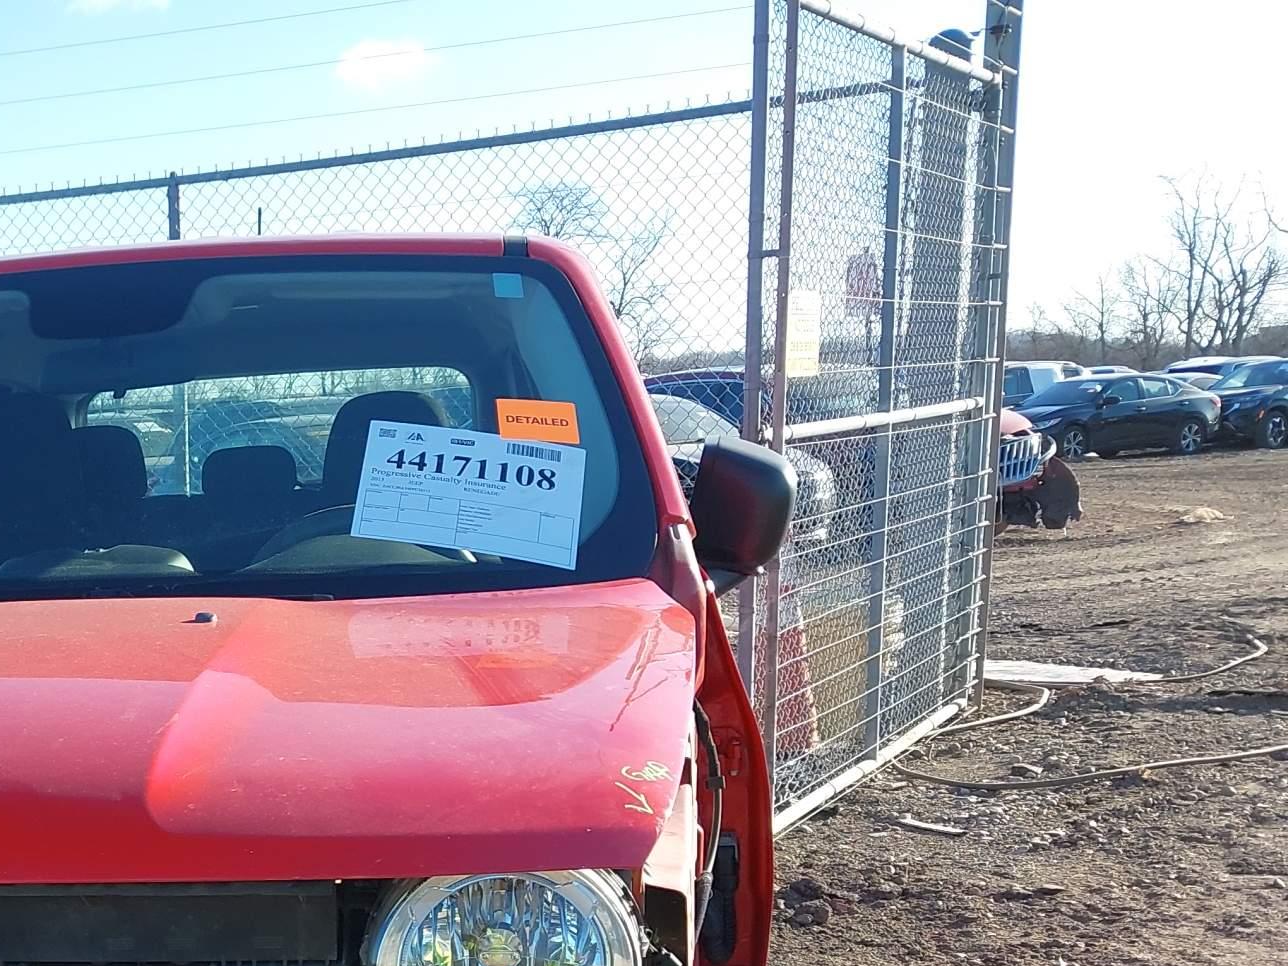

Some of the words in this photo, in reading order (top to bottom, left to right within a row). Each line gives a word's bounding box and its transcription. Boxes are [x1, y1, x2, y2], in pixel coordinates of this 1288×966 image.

[505, 414, 569, 427] DETAILED
[371, 467, 422, 479] Progressive
[423, 472, 462, 485] Casualty
[464, 478, 507, 491] Insurance
[386, 448, 557, 491] 44171108
